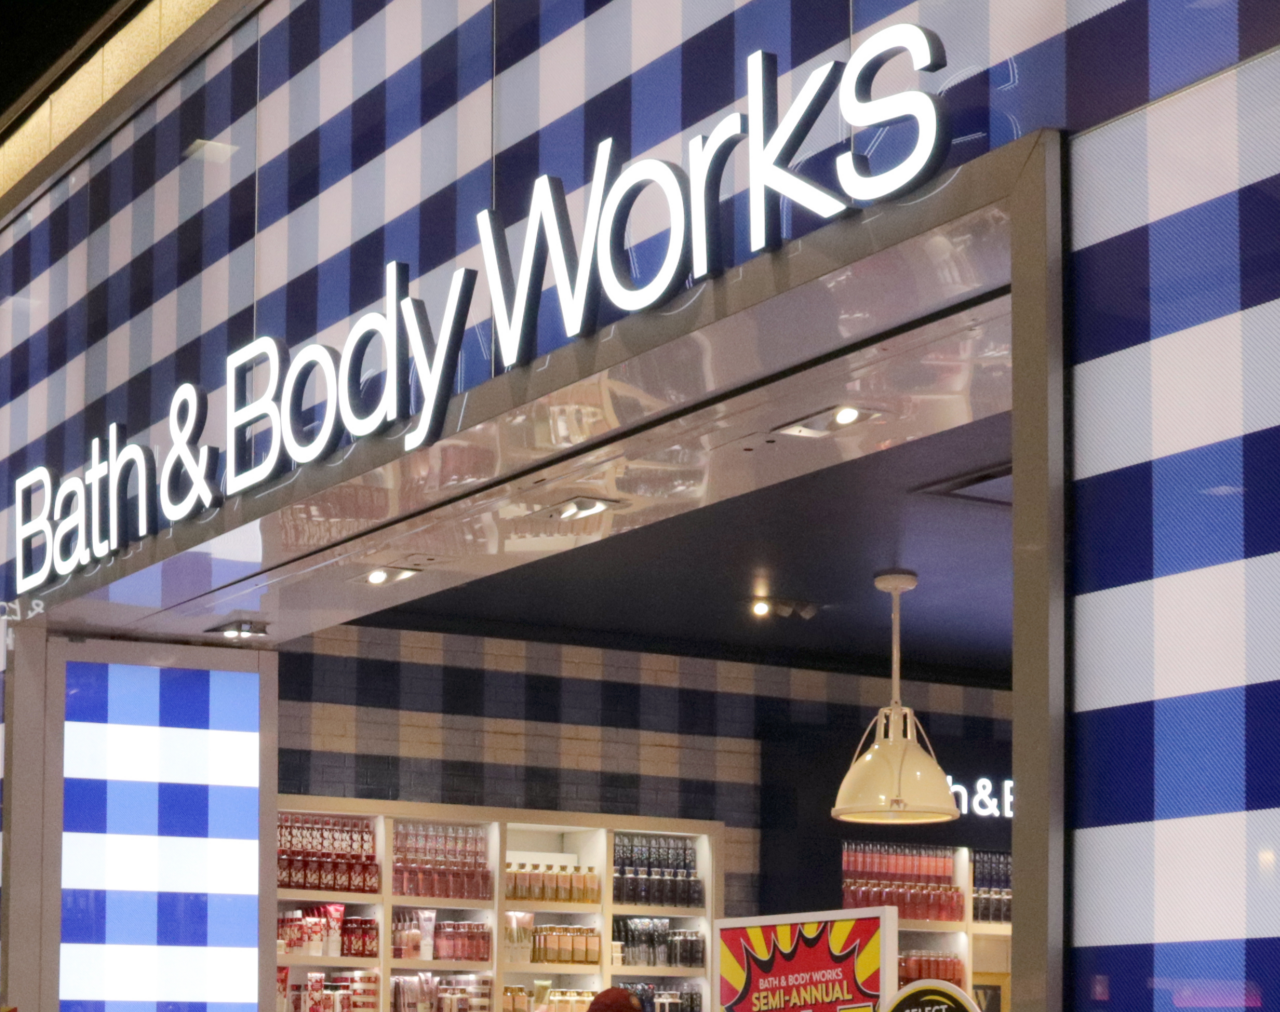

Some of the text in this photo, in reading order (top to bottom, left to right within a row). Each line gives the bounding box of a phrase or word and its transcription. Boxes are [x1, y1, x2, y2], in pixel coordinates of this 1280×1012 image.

[14, 21, 952, 596] Bath & Body Works
[758, 968, 843, 990] BATH & BODY WORKS
[751, 980, 853, 1012] SEMI-ANNUAL
